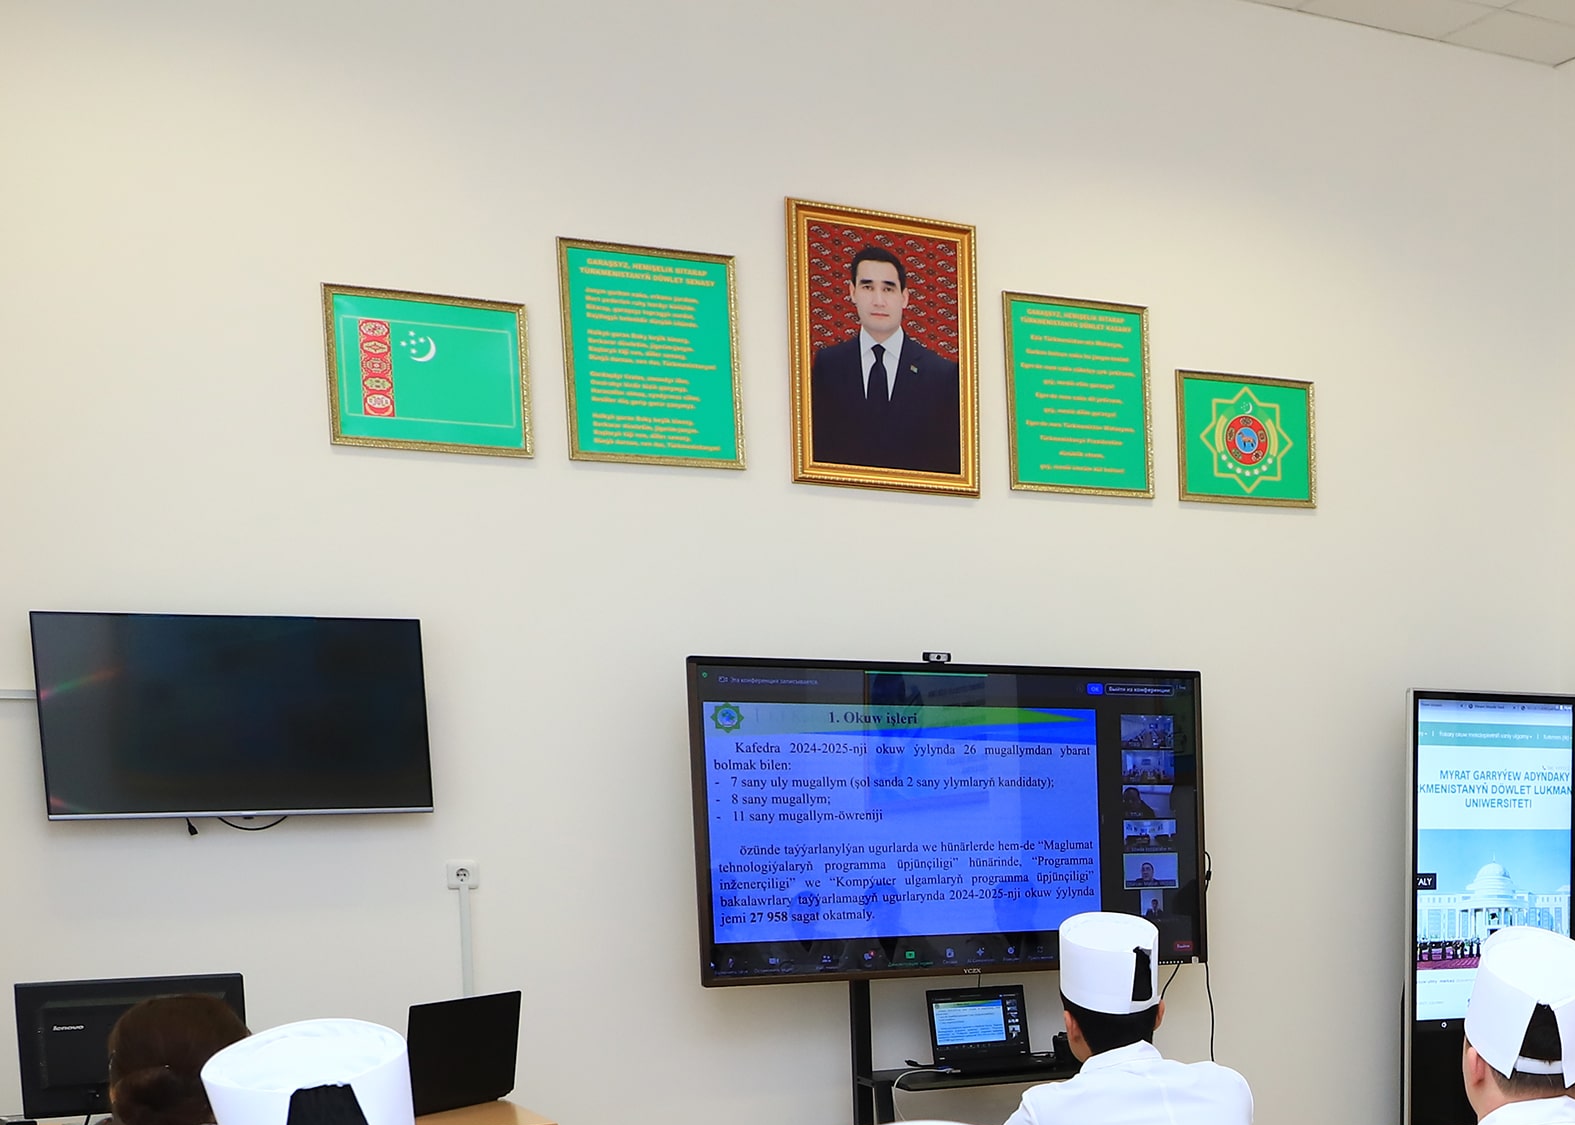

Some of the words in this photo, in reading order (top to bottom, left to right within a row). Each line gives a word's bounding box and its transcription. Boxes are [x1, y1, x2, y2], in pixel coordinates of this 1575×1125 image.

[828, 712, 839, 724] 1.
[844, 712, 882, 724] Okuw
[887, 712, 917, 725] işleri
[735, 743, 780, 753] Kafedra
[790, 743, 867, 754] 2024-2025-nji
[876, 744, 905, 754] okuw
[914, 744, 955, 756] ýylynda
[964, 745, 976, 755] 26
[985, 744, 1052, 757] mugallymdan
[1060, 746, 1090, 758] ybarat
[714, 760, 755, 770] bolmak
[760, 760, 791, 770] bilen:
[1440, 770, 1470, 780] MYRAT
[1473, 769, 1521, 781] GARRYÝEW
[1524, 771, 1570, 781] ADYNDAKY
[731, 778, 737, 787] 7
[742, 779, 767, 789] sany
[771, 777, 788, 788] uly
[792, 777, 846, 789] mugallym
[850, 777, 870, 789] (şol
[874, 777, 903, 788] sanda
[908, 778, 913, 787] 2
[917, 779, 939, 789] sany
[944, 776, 995, 789] ylymlaryň
[999, 777, 1054, 789] kandidaty);
[1492, 783, 1531, 794] DÖWLET
[732, 795, 738, 804] 8
[743, 796, 767, 807] sany
[772, 794, 830, 807] mugallym;
[1465, 798, 1532, 808] UNIWERSITETI
[734, 811, 744, 822] 11
[750, 813, 775, 824] sany
[779, 810, 883, 824] mugallym-öwreniji
[740, 845, 780, 855] özünde
[784, 843, 864, 857] taýýarlanylýan
[869, 842, 918, 856] ugurlarda
[941, 842, 994, 852] hünärlerde
[998, 841, 1035, 851] hem-de
[719, 860, 813, 874] tehnologiýalaryň
[825, 861, 886, 873] programma
[805, 879, 821, 887] we
[905, 874, 963, 886] ulgamlaryň
[972, 874, 1029, 885] programma
[720, 895, 792, 907] bakalawrlary
[798, 893, 878, 905] taýýarlamagyň
[883, 890, 944, 903] ugurlarynda
[950, 889, 1020, 901] 2024-2025-nji
[1025, 888, 1051, 897] okuw
[1056, 886, 1094, 899] ýylynda
[720, 914, 746, 926] jemi
[750, 913, 763, 923] 27
[768, 912, 788, 922] 958
[791, 911, 820, 923] sagat
[823, 909, 875, 921] okatmaly.
